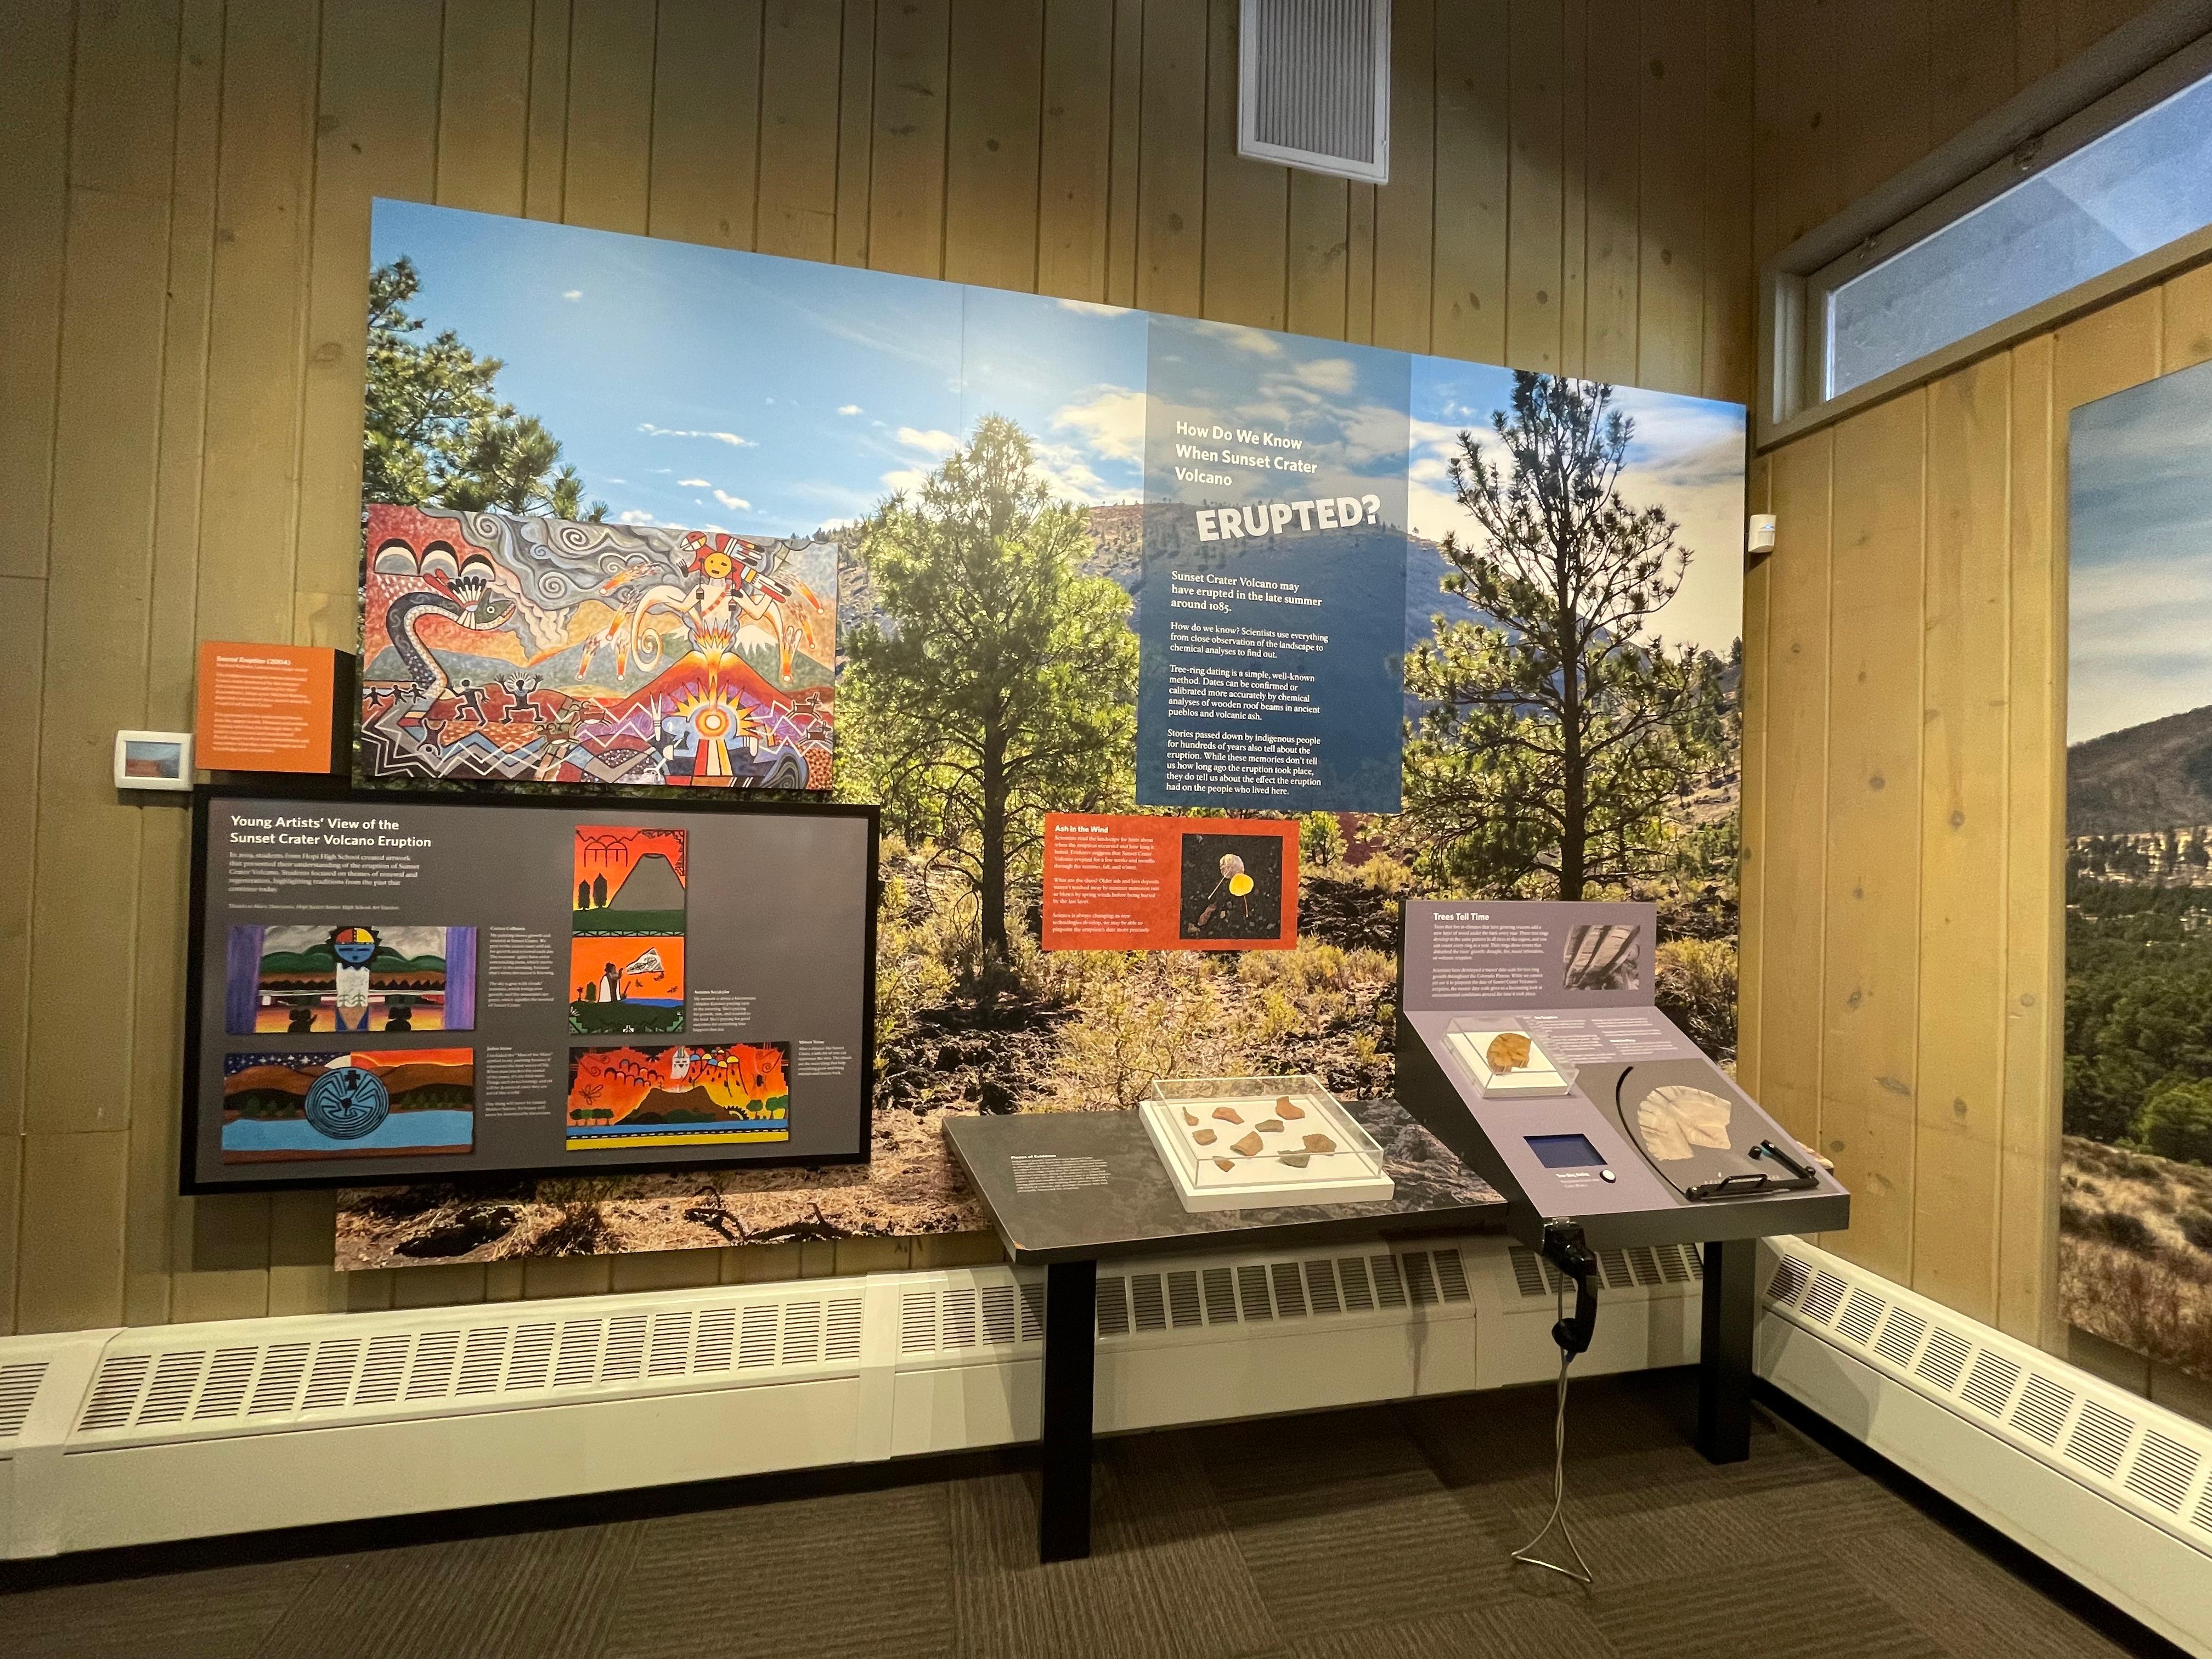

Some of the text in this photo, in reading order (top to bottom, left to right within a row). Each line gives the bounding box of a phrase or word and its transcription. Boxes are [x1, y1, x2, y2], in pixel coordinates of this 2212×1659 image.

[1176, 421, 1302, 449] How Do We Know
[1175, 443, 1318, 473] When Sunset Crater
[1174, 466, 1232, 486] Volcano
[1195, 494, 1381, 543] ERUPTED?
[1171, 571, 1299, 593] Sunset Crater Volcano may
[1171, 584, 1322, 606] have erupted in the late summer
[1171, 600, 1206, 609] around
[1170, 621, 1189, 630] How
[1190, 623, 1201, 631] do
[1215, 625, 1240, 634] know?
[1241, 627, 1276, 637] Scientists
[1290, 633, 1328, 644] everything
[1170, 632, 1189, 641] from
[1190, 634, 1210, 642] close
[1211, 635, 1255, 646] observation
[1256, 639, 1265, 647] of
[1266, 639, 1278, 648] the
[1279, 640, 1314, 652] landscape
[1170, 644, 1204, 653] chemical
[1205, 647, 1236, 656] analyses
[1246, 648, 1261, 657] find
[1169, 664, 1205, 676] Tree-ring
[1206, 667, 1230, 678] dating
[1231, 668, 1237, 676] is
[1244, 670, 1271, 680] simple,
[1272, 672, 1314, 681] well-known
[1169, 676, 1200, 684] method.
[1202, 678, 1224, 686] Dates
[1240, 680, 1249, 688] be
[1250, 681, 1288, 690] confirmed
[1169, 687, 1206, 696] calibrated
[1228, 691, 1266, 701] accurately
[1267, 692, 1277, 702] by
[1277, 693, 1310, 702] chemical
[1168, 698, 1200, 707] analyses
[1260, 702, 1284, 710] beams
[1168, 709, 1198, 717] pueblos
[1215, 710, 1246, 719] volcanic
[1167, 729, 1321, 746] Stories passed down by indigenous people
[1180, 740, 1216, 749] hundreds
[1217, 742, 1226, 750] of
[1247, 743, 1262, 752] also
[1276, 745, 1297, 753] about
[1299, 746, 1310, 754] the
[1166, 752, 1201, 762] eruption.
[1203, 752, 1226, 760] While
[1227, 753, 1246, 761] these
[1306, 757, 1317, 765] tell
[1195, 763, 1212, 772] long
[1212, 765, 1227, 773] ago
[1241, 765, 1273, 774] eruption
[1274, 766, 1291, 774] took
[1293, 766, 1314, 776] place,
[1166, 772, 1183, 782] they
[1219, 774, 1240, 782] about
[1242, 775, 1254, 783] the
[1255, 775, 1276, 783] effect
[1290, 777, 1321, 787] eruption
[1166, 782, 1181, 791] had
[1194, 783, 1206, 792] the
[1207, 785, 1233, 794] people
[1233, 785, 1251, 793] who
[1252, 786, 1269, 794] lived
[1271, 786, 1289, 794] here.
[230, 815, 399, 830] Young Artists' View of the
[229, 832, 431, 848] Sunset Crater Volcano Eruption
[1455, 912, 1469, 921] Tell
[1470, 912, 1489, 921] Time
